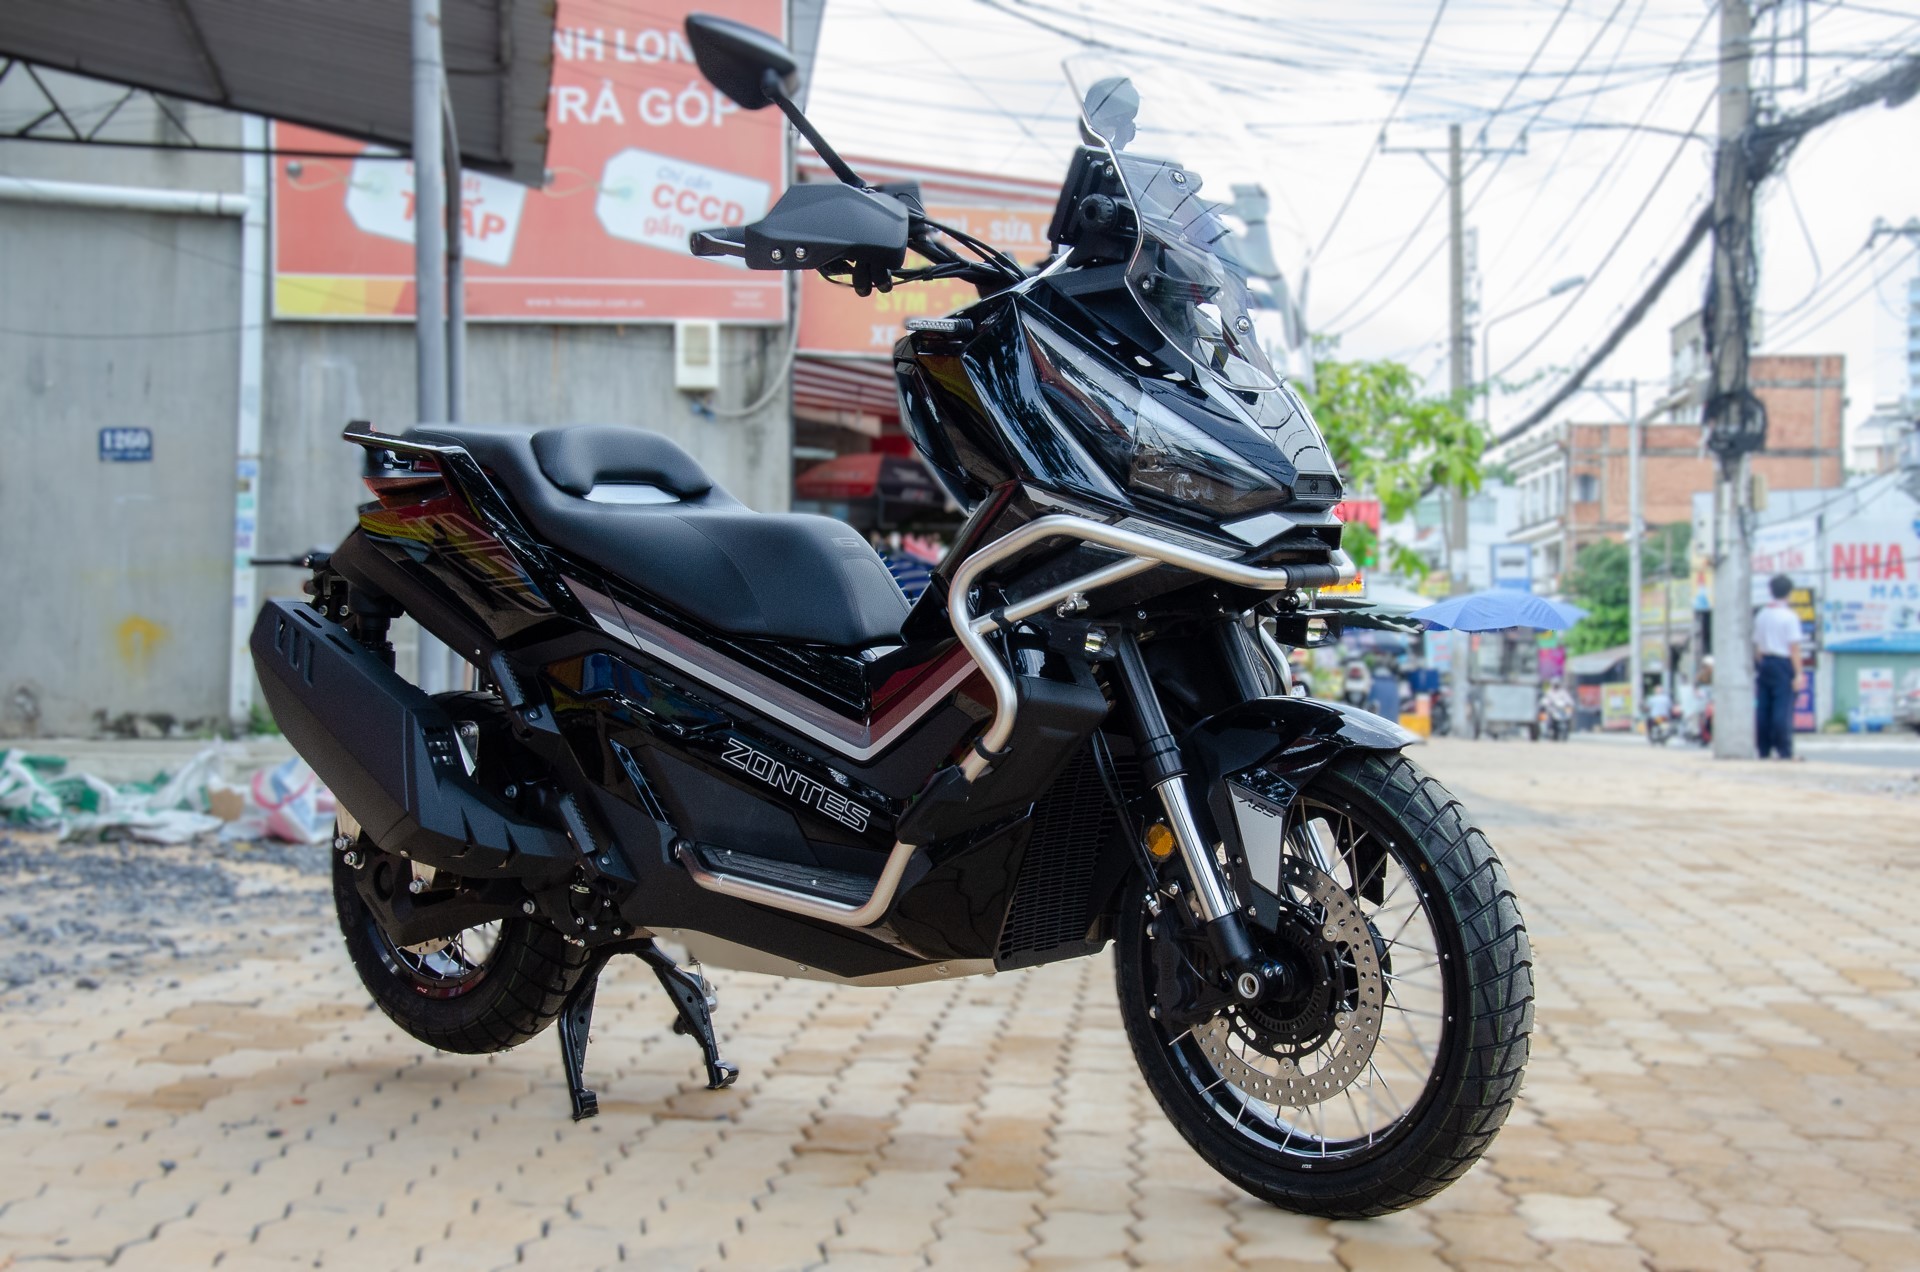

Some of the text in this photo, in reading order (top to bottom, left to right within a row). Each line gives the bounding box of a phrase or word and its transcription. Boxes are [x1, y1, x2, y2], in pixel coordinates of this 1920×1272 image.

[548, 78, 625, 125] RẢ
[401, 190, 507, 241] TẤP
[651, 183, 745, 227] CCCD
[876, 293, 927, 313] SYM
[1833, 543, 1906, 580] NHA
[721, 737, 872, 833] ZONTES
[1238, 798, 1280, 818] ABS
